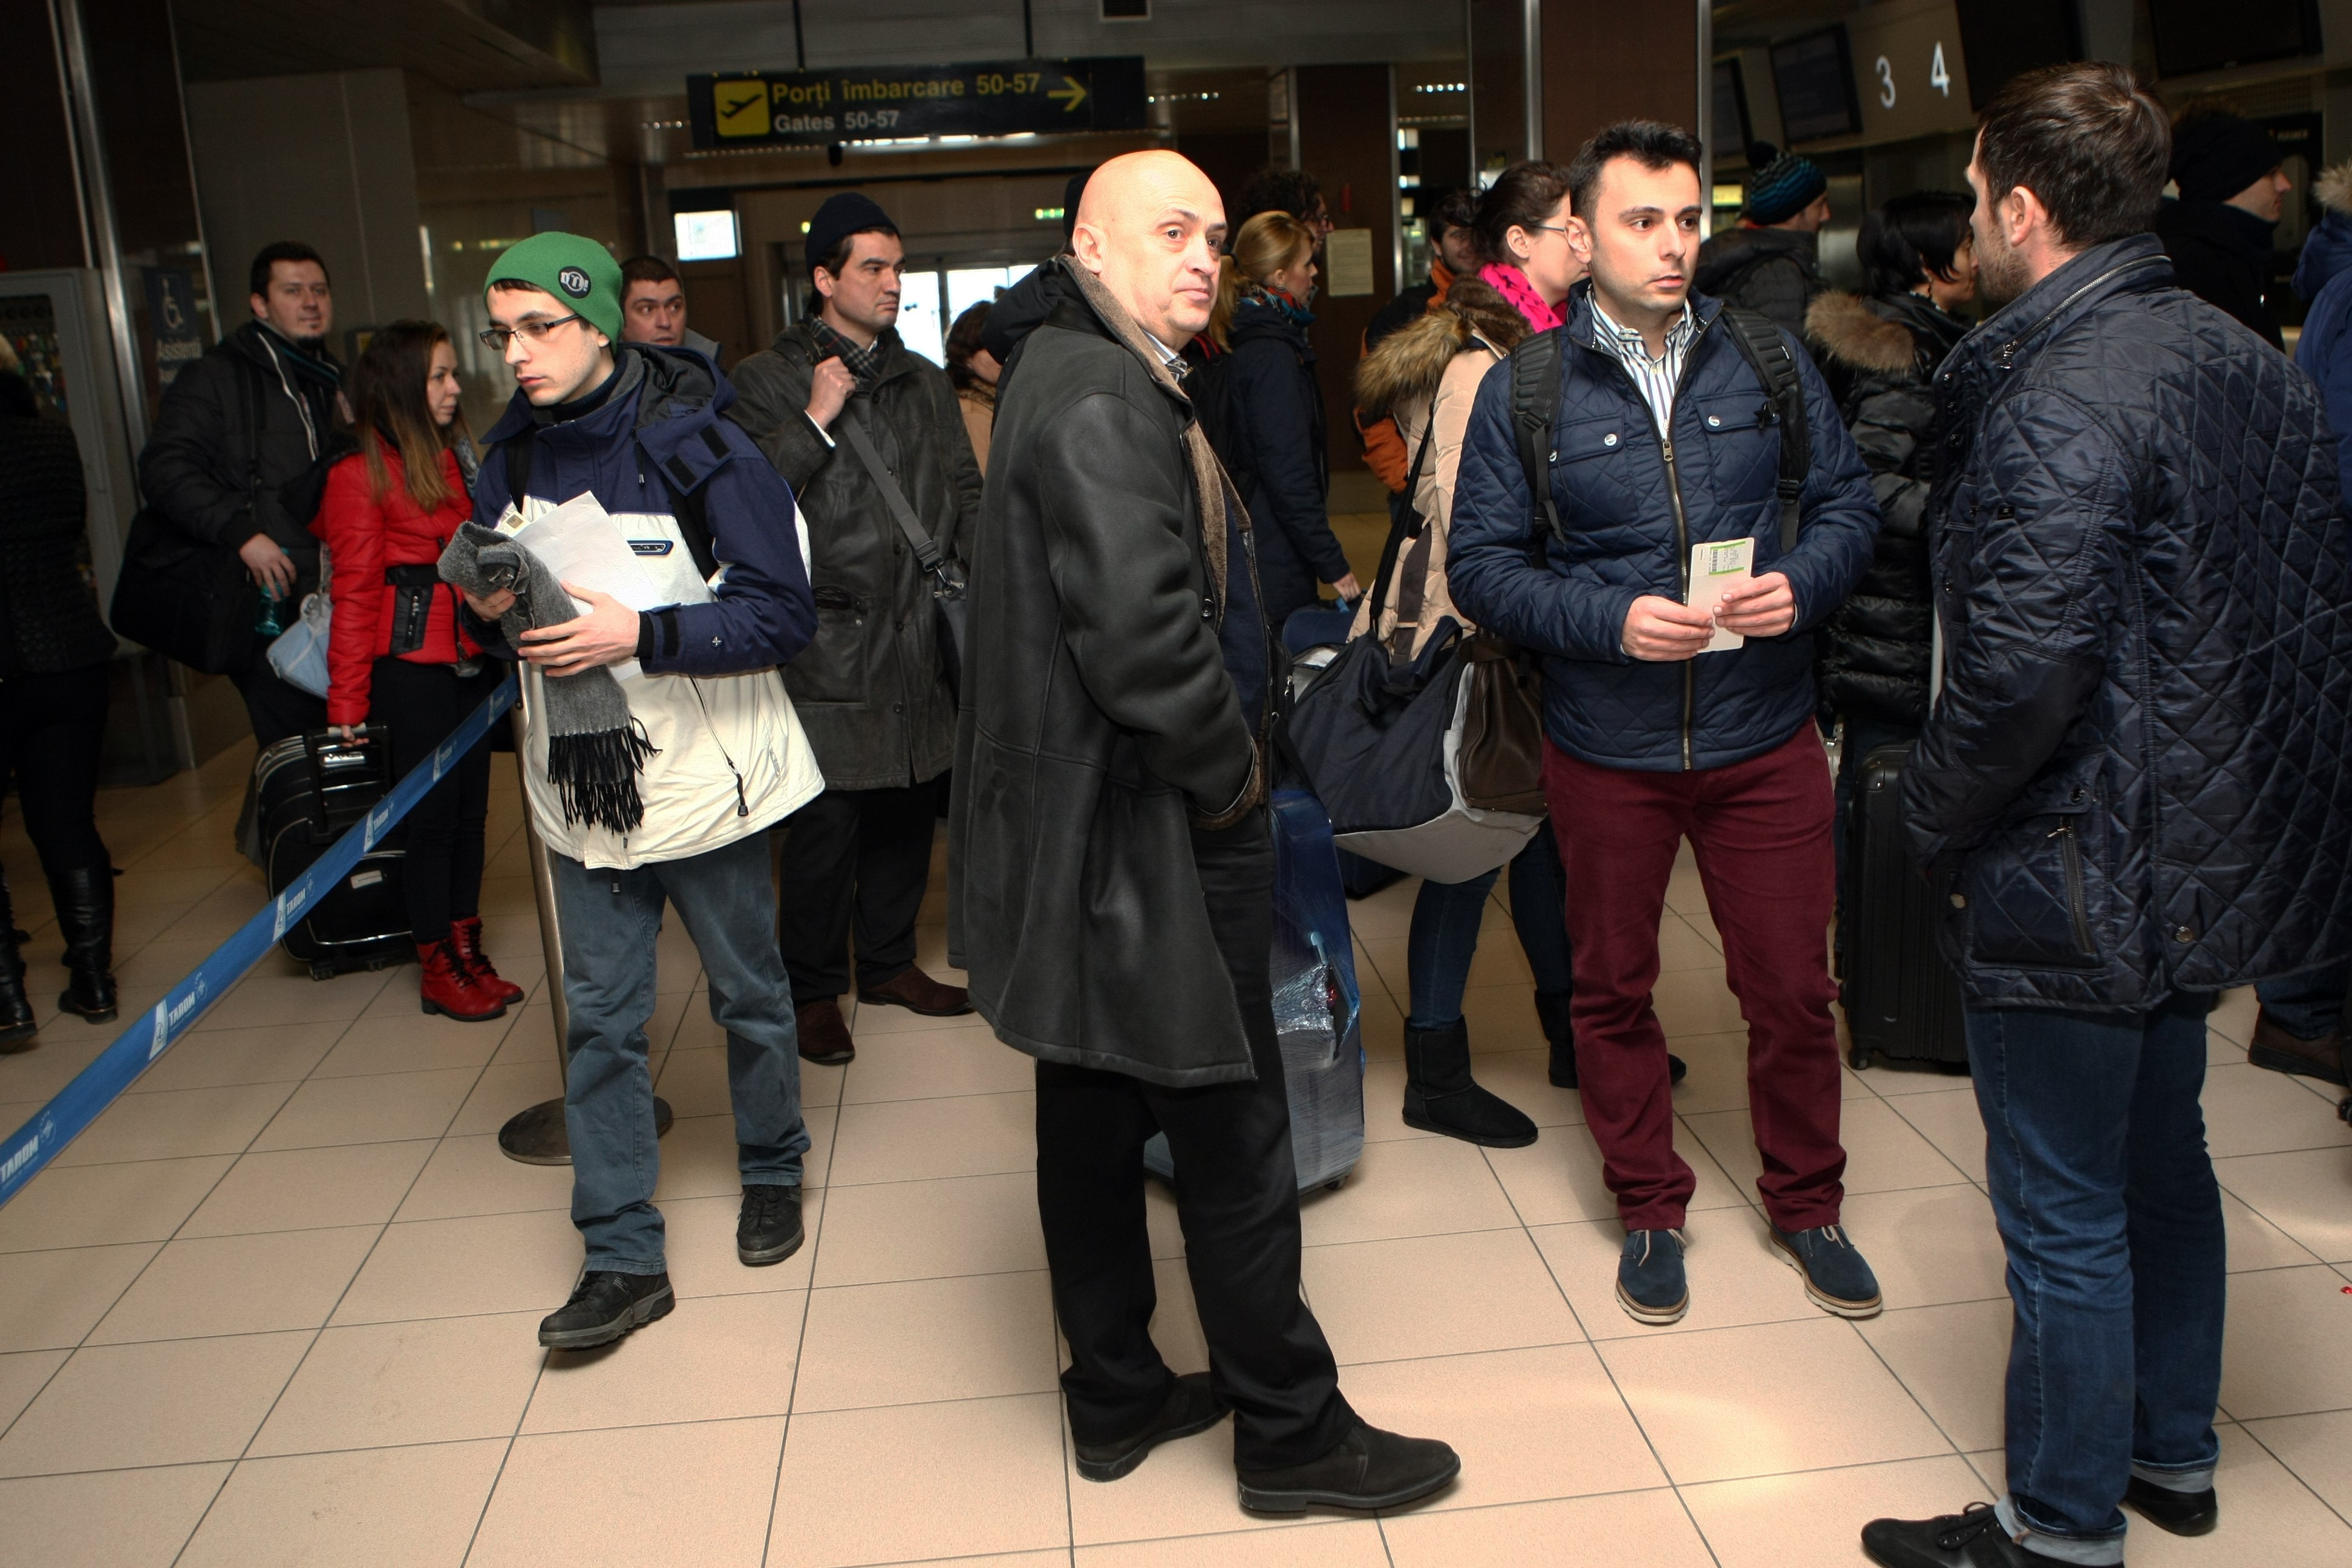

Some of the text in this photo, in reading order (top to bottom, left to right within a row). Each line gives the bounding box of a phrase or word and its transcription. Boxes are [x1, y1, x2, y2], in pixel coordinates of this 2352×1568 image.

[976, 72, 1041, 95] 50-57
[1876, 41, 1950, 109] 3 4
[774, 109, 900, 133] Gates 50-57
[286, 888, 306, 915] TAROM
[168, 991, 195, 1027] TAROM
[0, 1134, 39, 1183] TAROM
